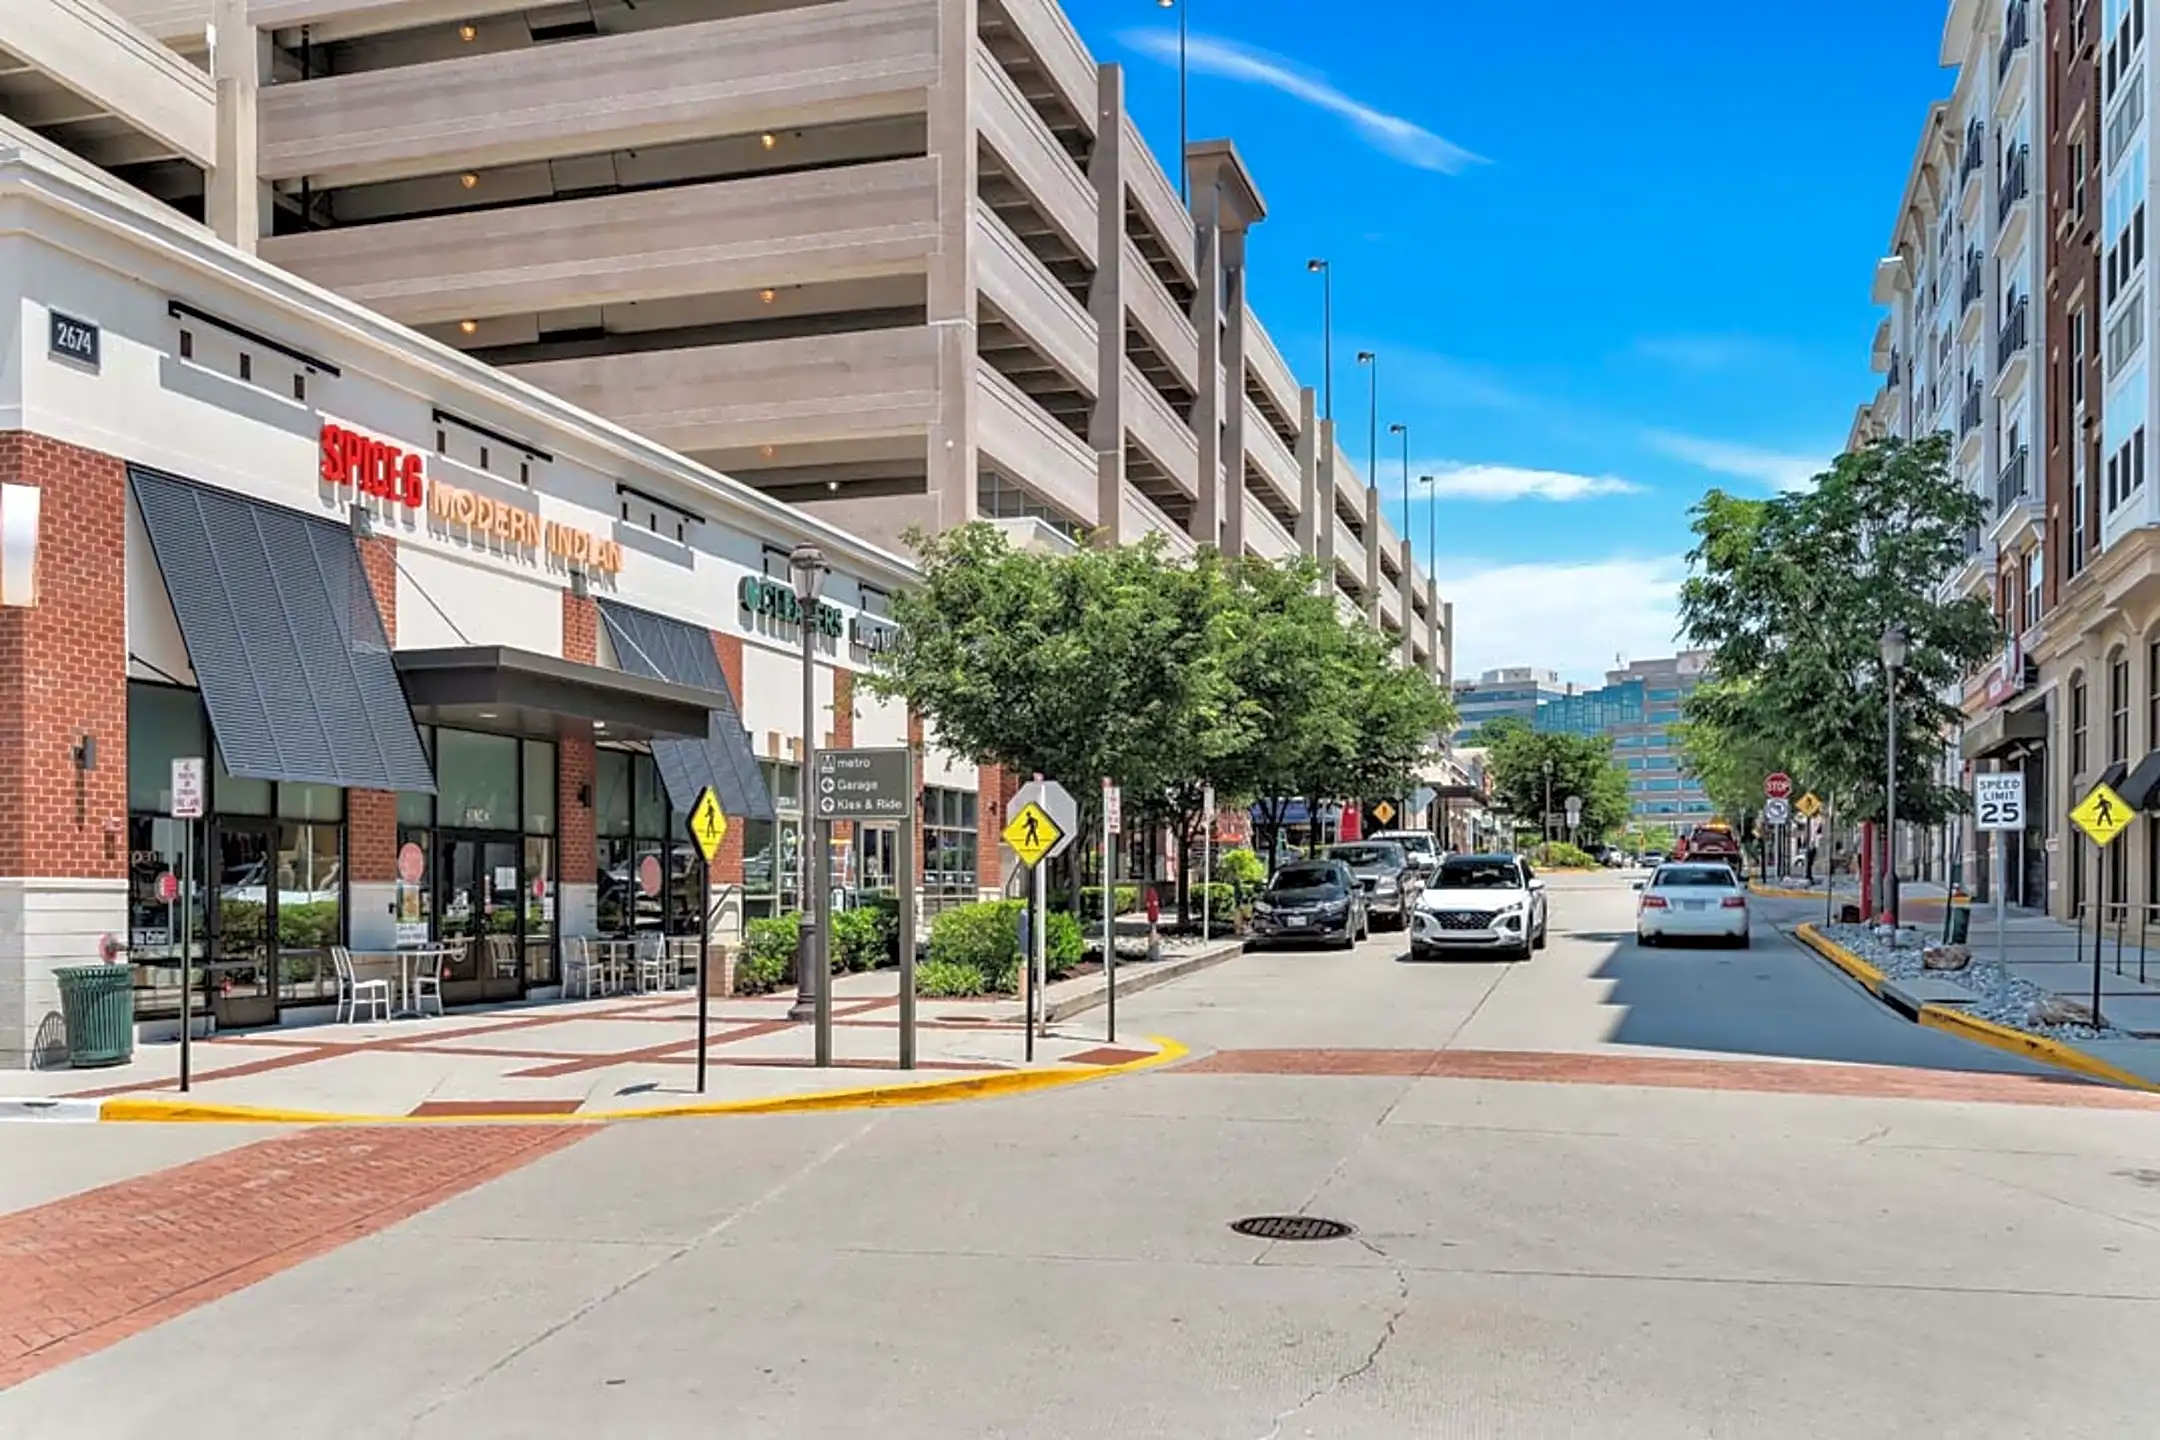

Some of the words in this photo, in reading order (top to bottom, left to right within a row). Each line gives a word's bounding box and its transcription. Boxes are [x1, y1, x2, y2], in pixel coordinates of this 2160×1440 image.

[57, 321, 92, 356] 2674
[428, 479, 541, 546] MODERN
[547, 519, 625, 574] INDIAN
[837, 757, 871, 769] metro
[837, 778, 878, 792] Garage
[1766, 780, 1790, 792] STOP
[1979, 779, 2021, 790] SPEED
[1982, 790, 2015, 801] LIMIT
[837, 798, 862, 810] Kiss
[864, 798, 873, 810] &
[876, 798, 903, 810] Ride
[1981, 802, 2019, 823] 25
